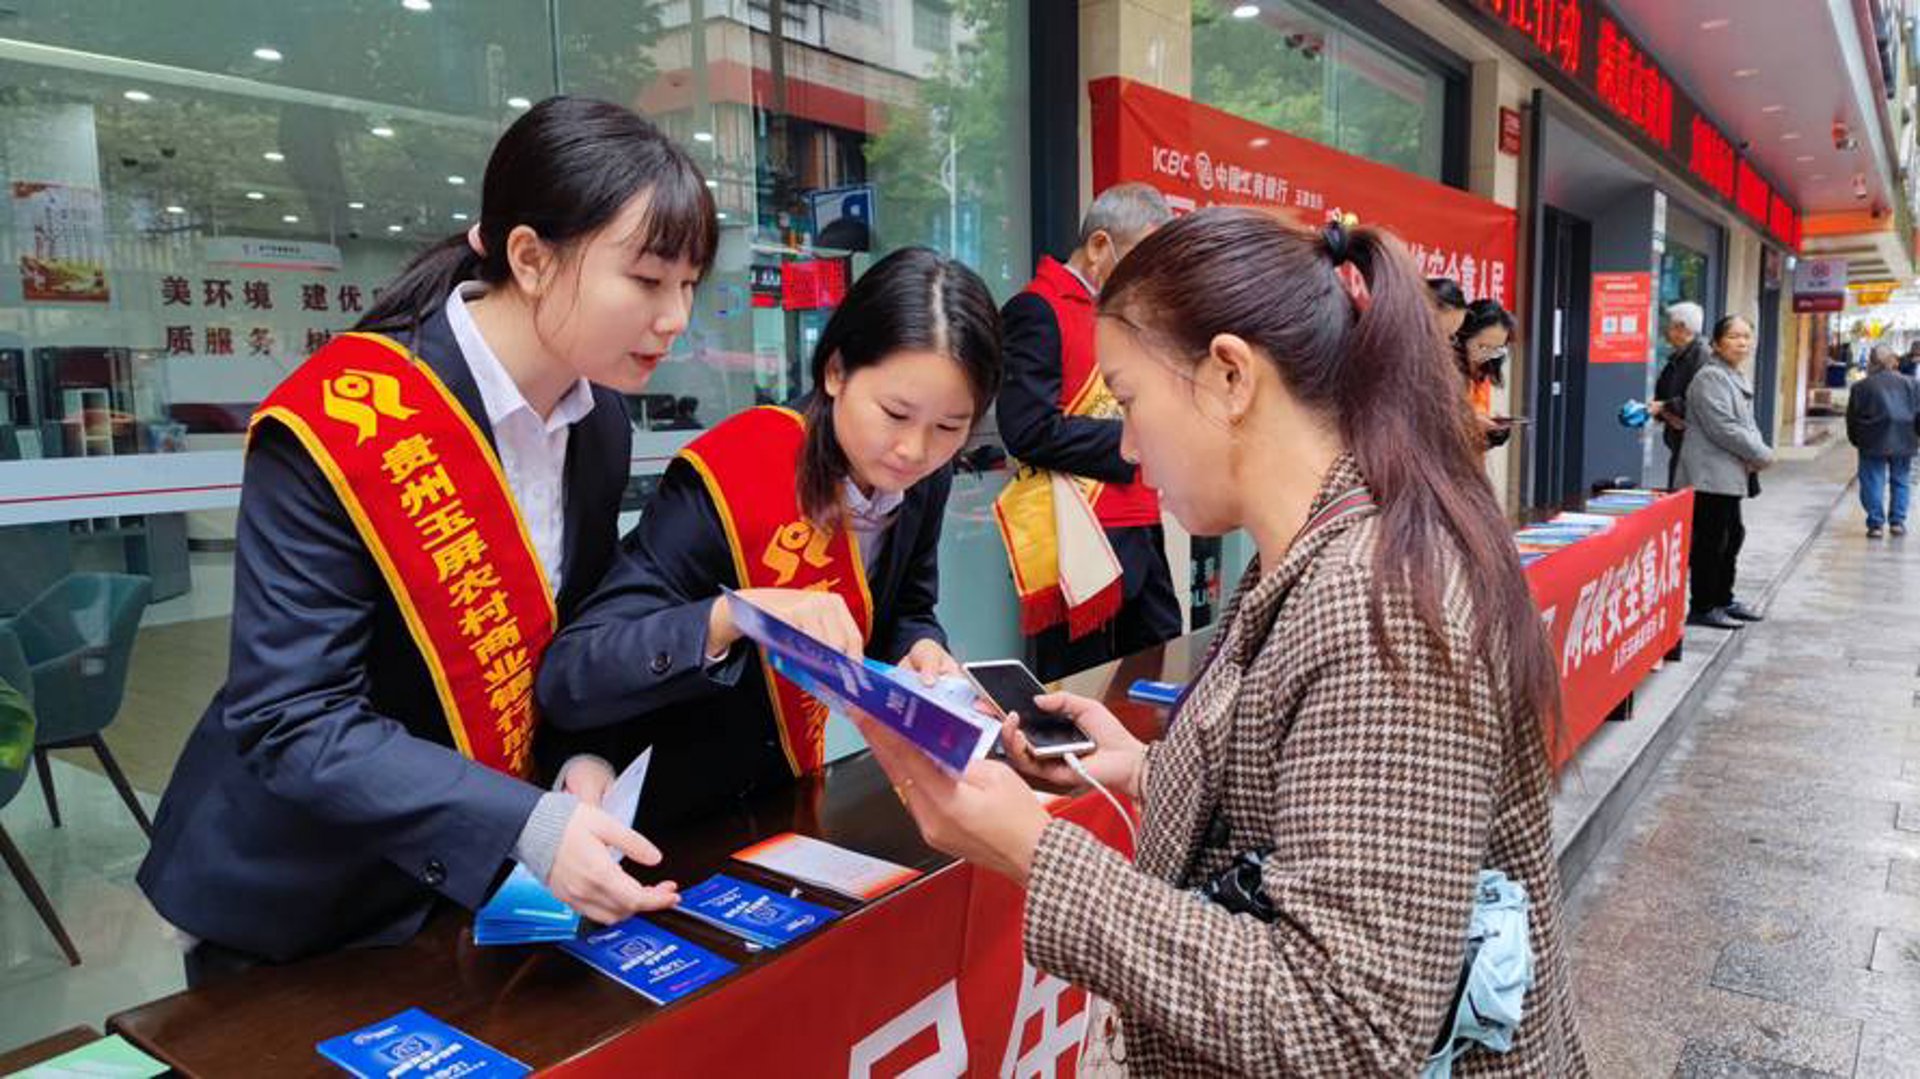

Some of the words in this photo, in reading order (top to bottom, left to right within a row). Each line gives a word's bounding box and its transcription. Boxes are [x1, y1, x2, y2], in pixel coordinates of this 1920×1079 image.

[1152, 146, 1191, 179] ICBC
[1215, 161, 1288, 204] 中国工商银行
[162, 275, 273, 310] 美环境
[166, 325, 275, 356] 质服务
